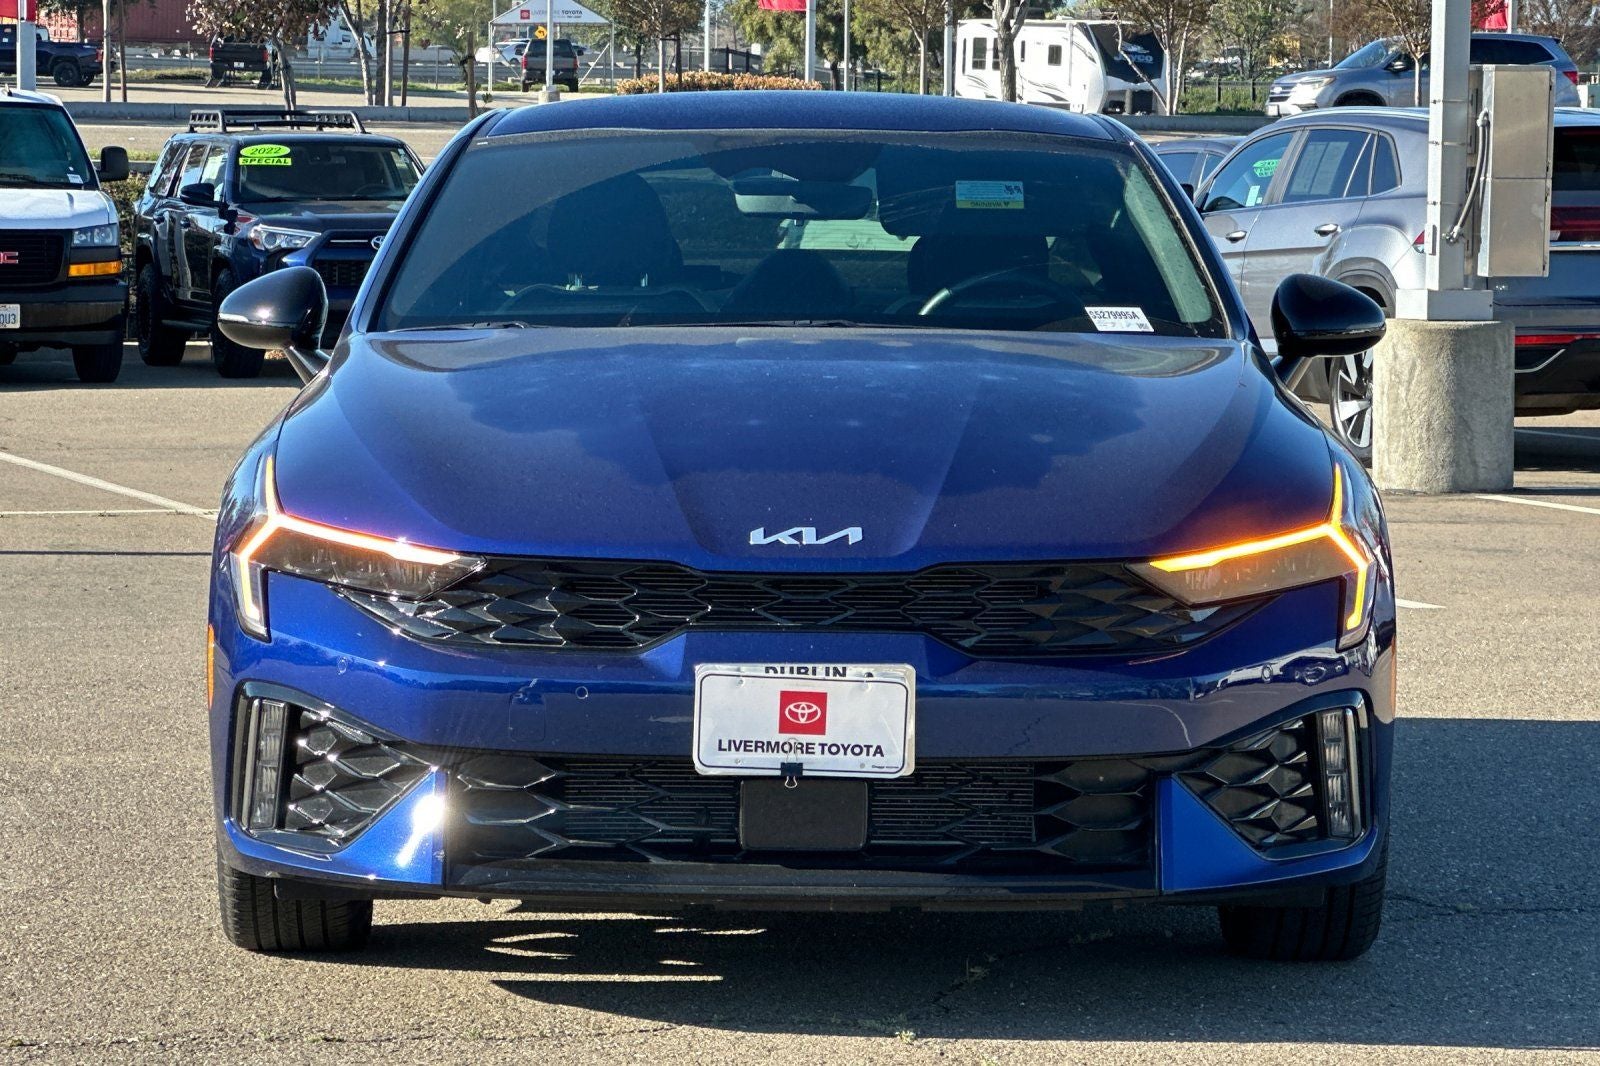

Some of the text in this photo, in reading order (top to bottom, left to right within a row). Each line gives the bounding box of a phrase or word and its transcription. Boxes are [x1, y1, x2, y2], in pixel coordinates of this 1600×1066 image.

[250, 147, 281, 155] 2022
[750, 527, 862, 545] KIA
[718, 739, 885, 757] LIVERMORE TOYOTA
